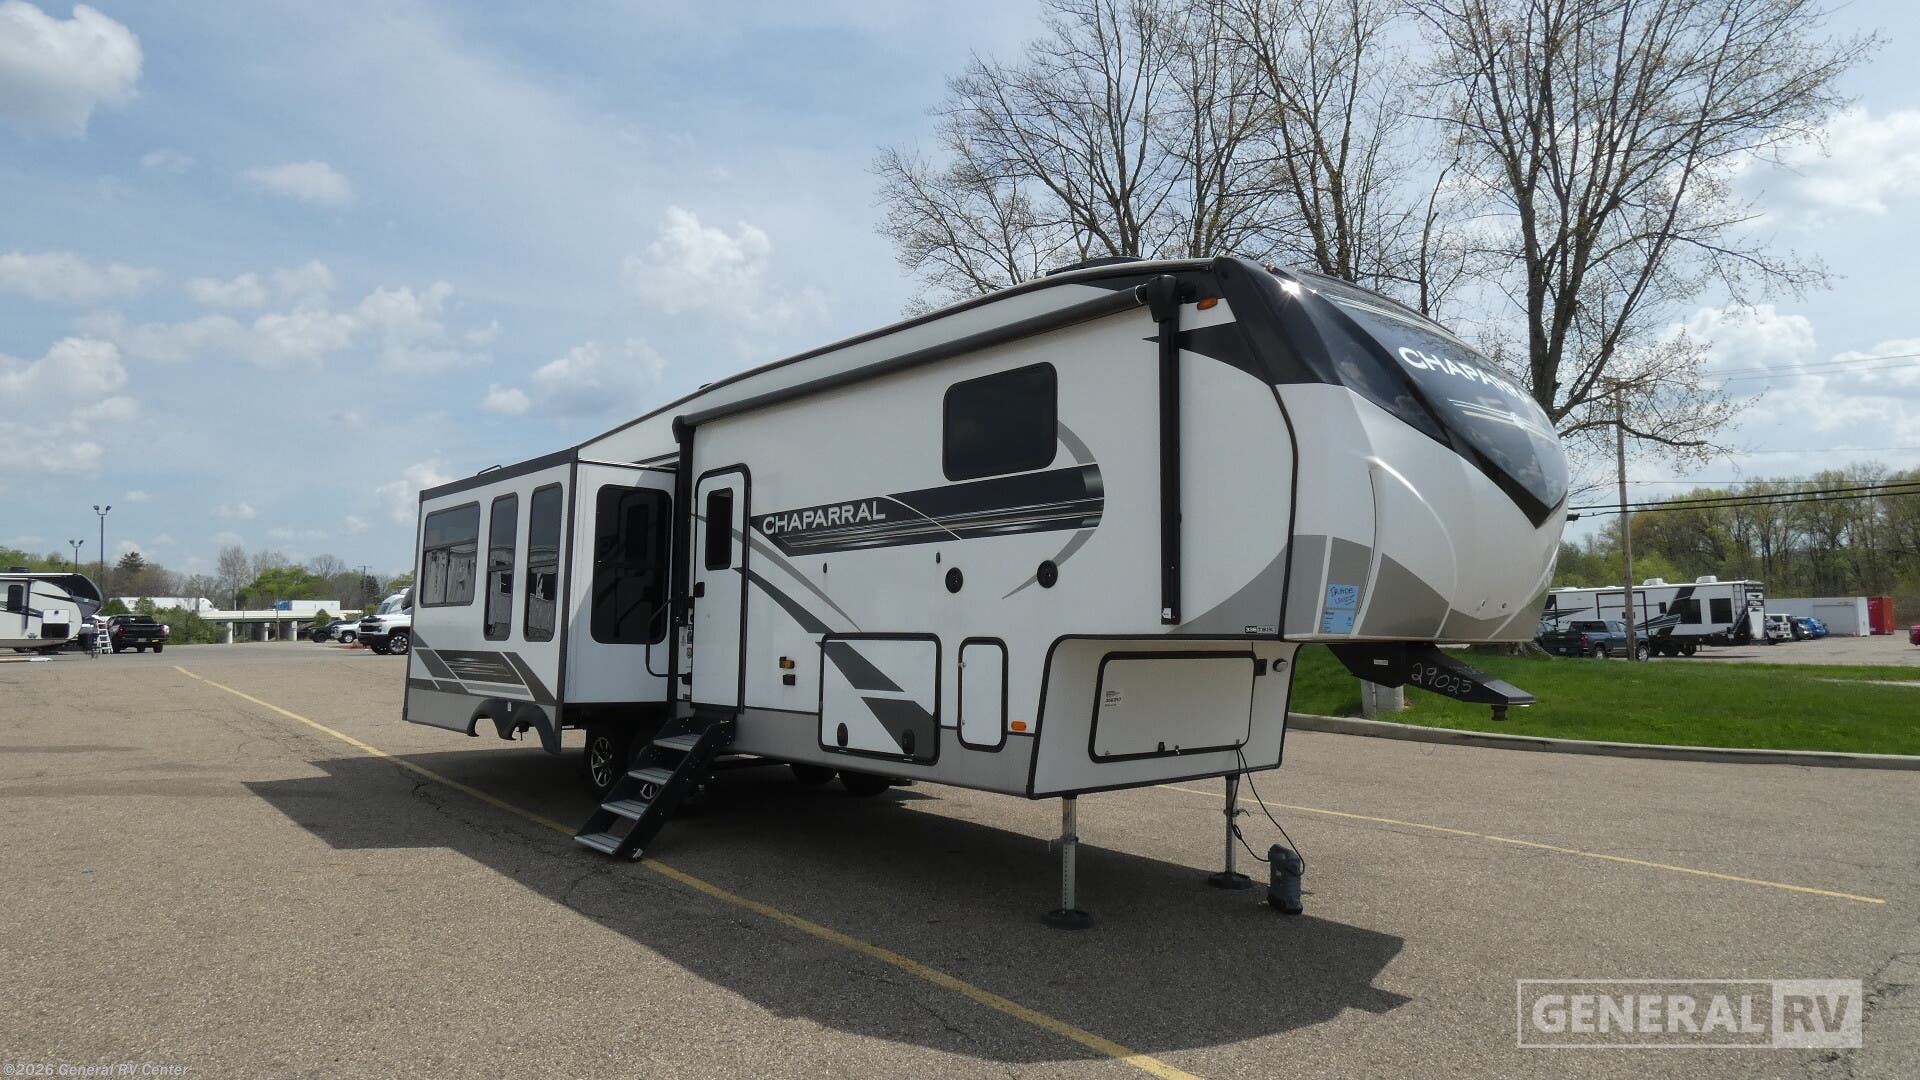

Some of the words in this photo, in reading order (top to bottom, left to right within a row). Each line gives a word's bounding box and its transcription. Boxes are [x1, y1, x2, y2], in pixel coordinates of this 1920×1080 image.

[1398, 346, 1529, 404] CHAPARR
[762, 500, 886, 535] CHAPARRAL
[1411, 662, 1473, 695] 29025
